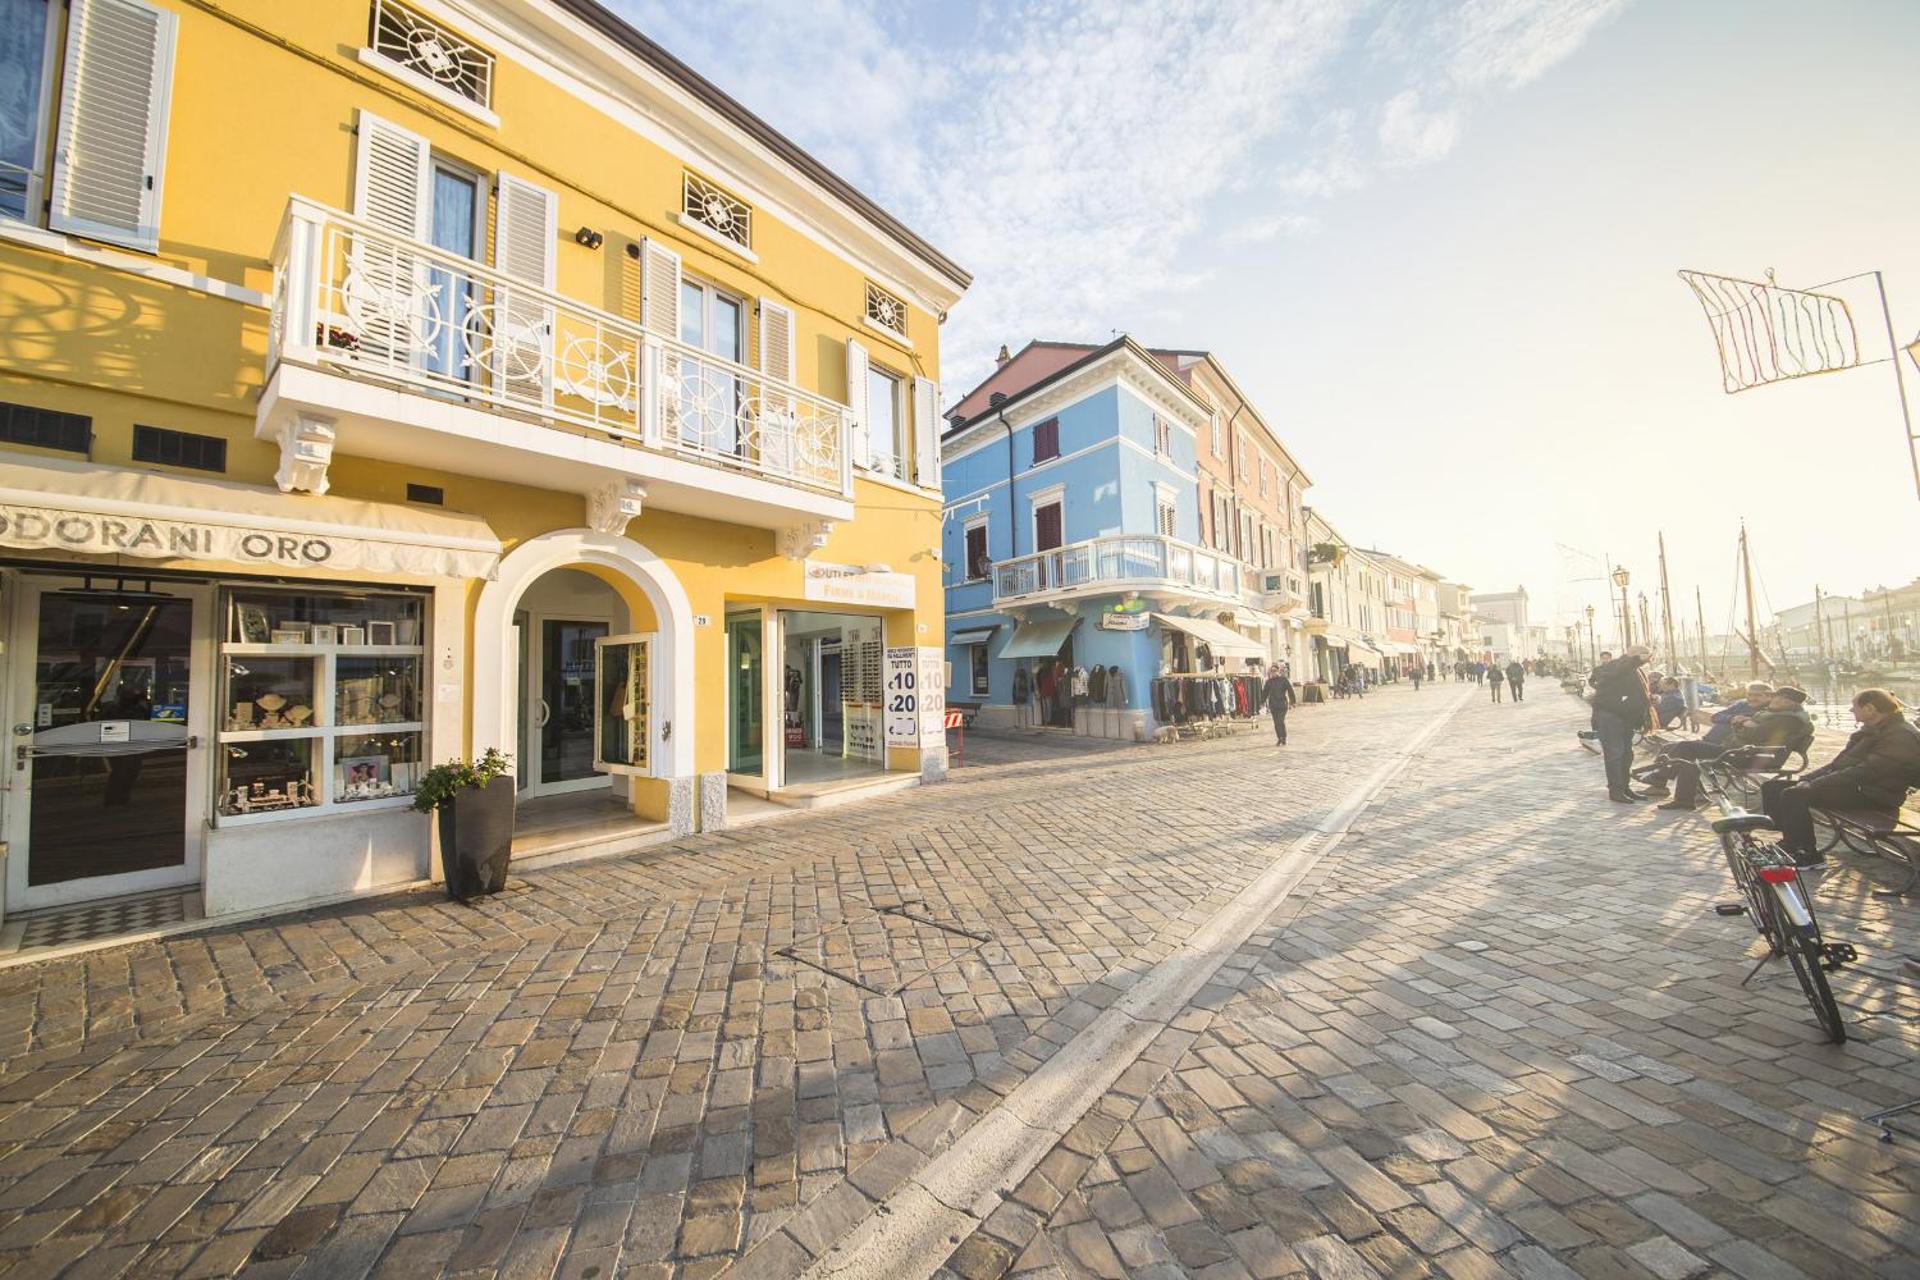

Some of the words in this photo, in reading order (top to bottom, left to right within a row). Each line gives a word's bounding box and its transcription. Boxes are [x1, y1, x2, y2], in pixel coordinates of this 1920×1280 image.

[0, 511, 212, 554] DORANI
[240, 533, 332, 563] ORO
[891, 660, 912, 669] TUTTO
